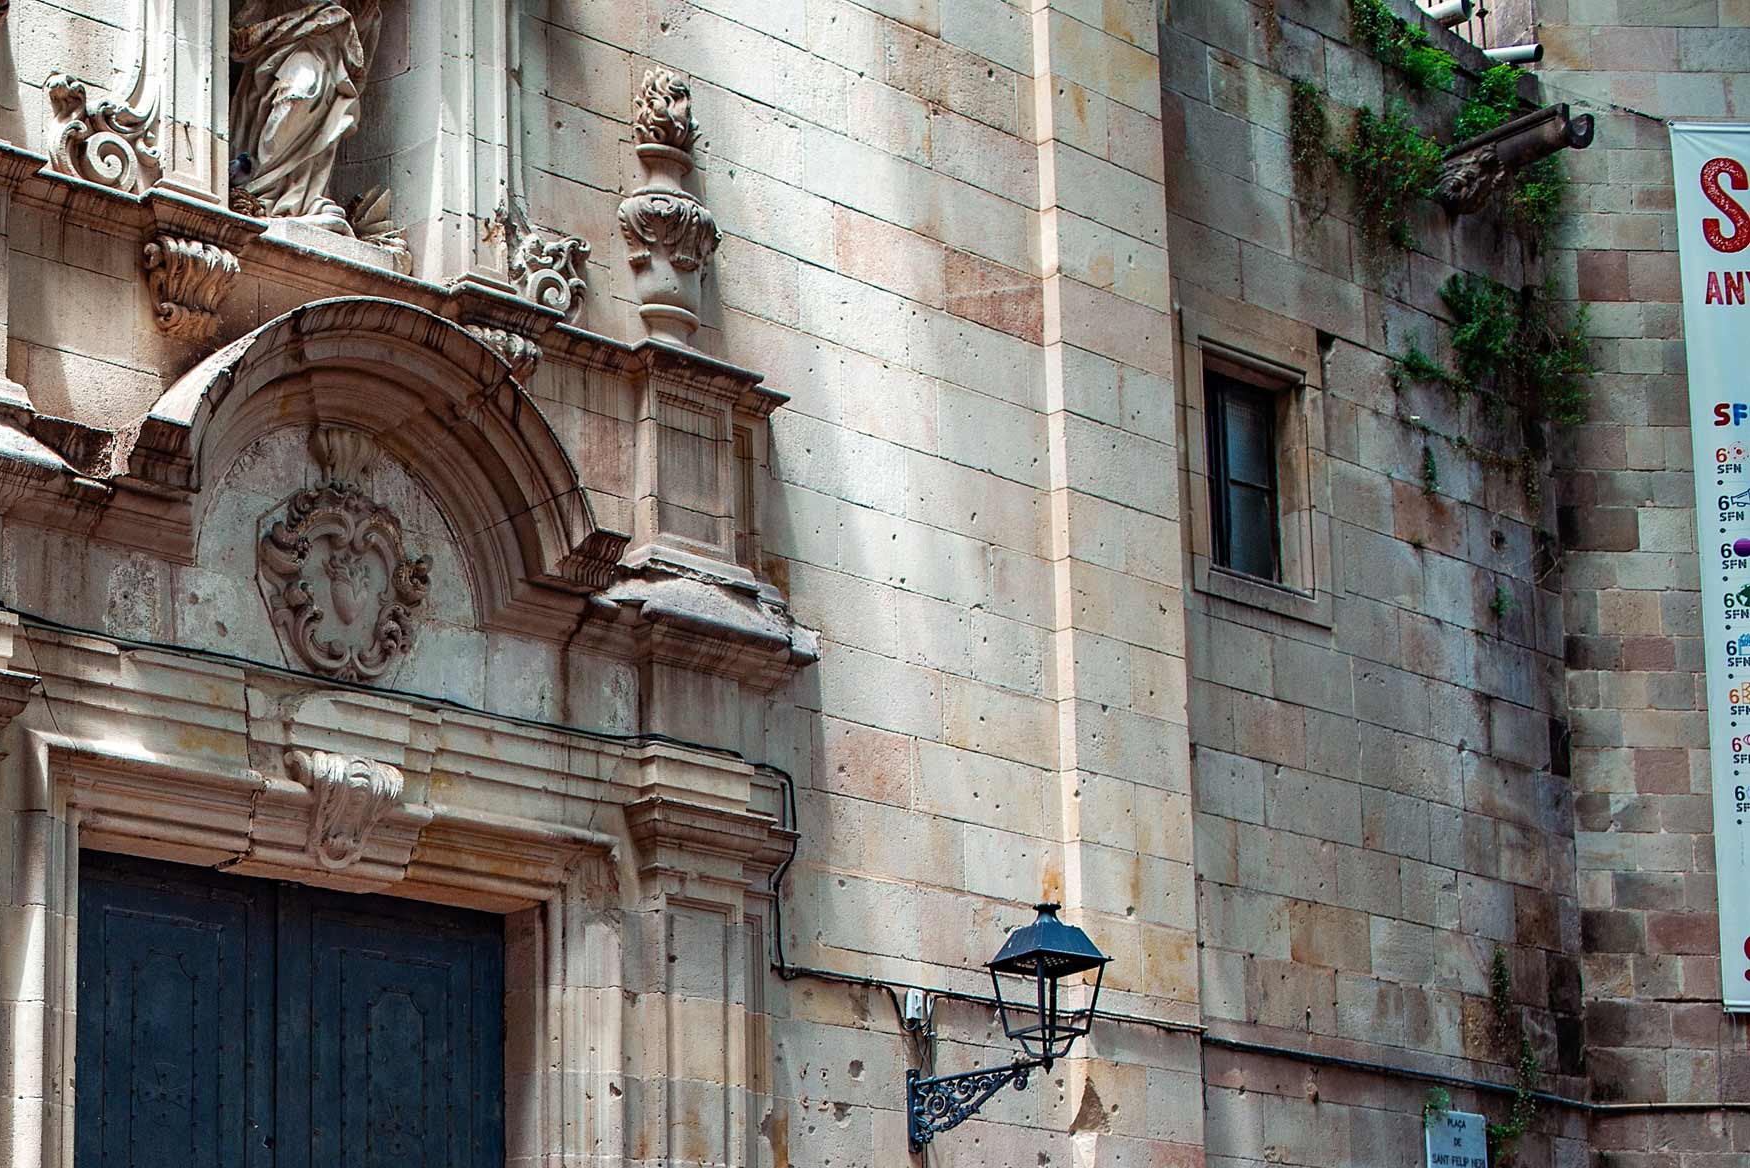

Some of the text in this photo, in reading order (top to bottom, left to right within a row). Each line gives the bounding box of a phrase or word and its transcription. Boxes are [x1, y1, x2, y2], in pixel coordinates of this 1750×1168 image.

[1700, 157, 1750, 253] S
[1705, 271, 1750, 305] AN
[1714, 403, 1750, 426] SF
[1716, 448, 1728, 463] 6
[1717, 464, 1742, 474] SFN
[1718, 495, 1730, 511] 6
[1719, 511, 1744, 522] SFN
[1720, 543, 1732, 559] 6
[1722, 559, 1747, 569] SFN
[1723, 593, 1735, 608] 6
[1725, 609, 1750, 619] SFN
[1726, 640, 1737, 656] 6
[1728, 688, 1740, 704] 6
[1732, 737, 1742, 752] 6
[1735, 785, 1745, 801] 6
[1447, 1118, 1466, 1132] PLAÇA
[1453, 1137, 1462, 1147] DE
[1432, 1152, 1449, 1165] SANT
[1451, 1155, 1469, 1167] FELIP
